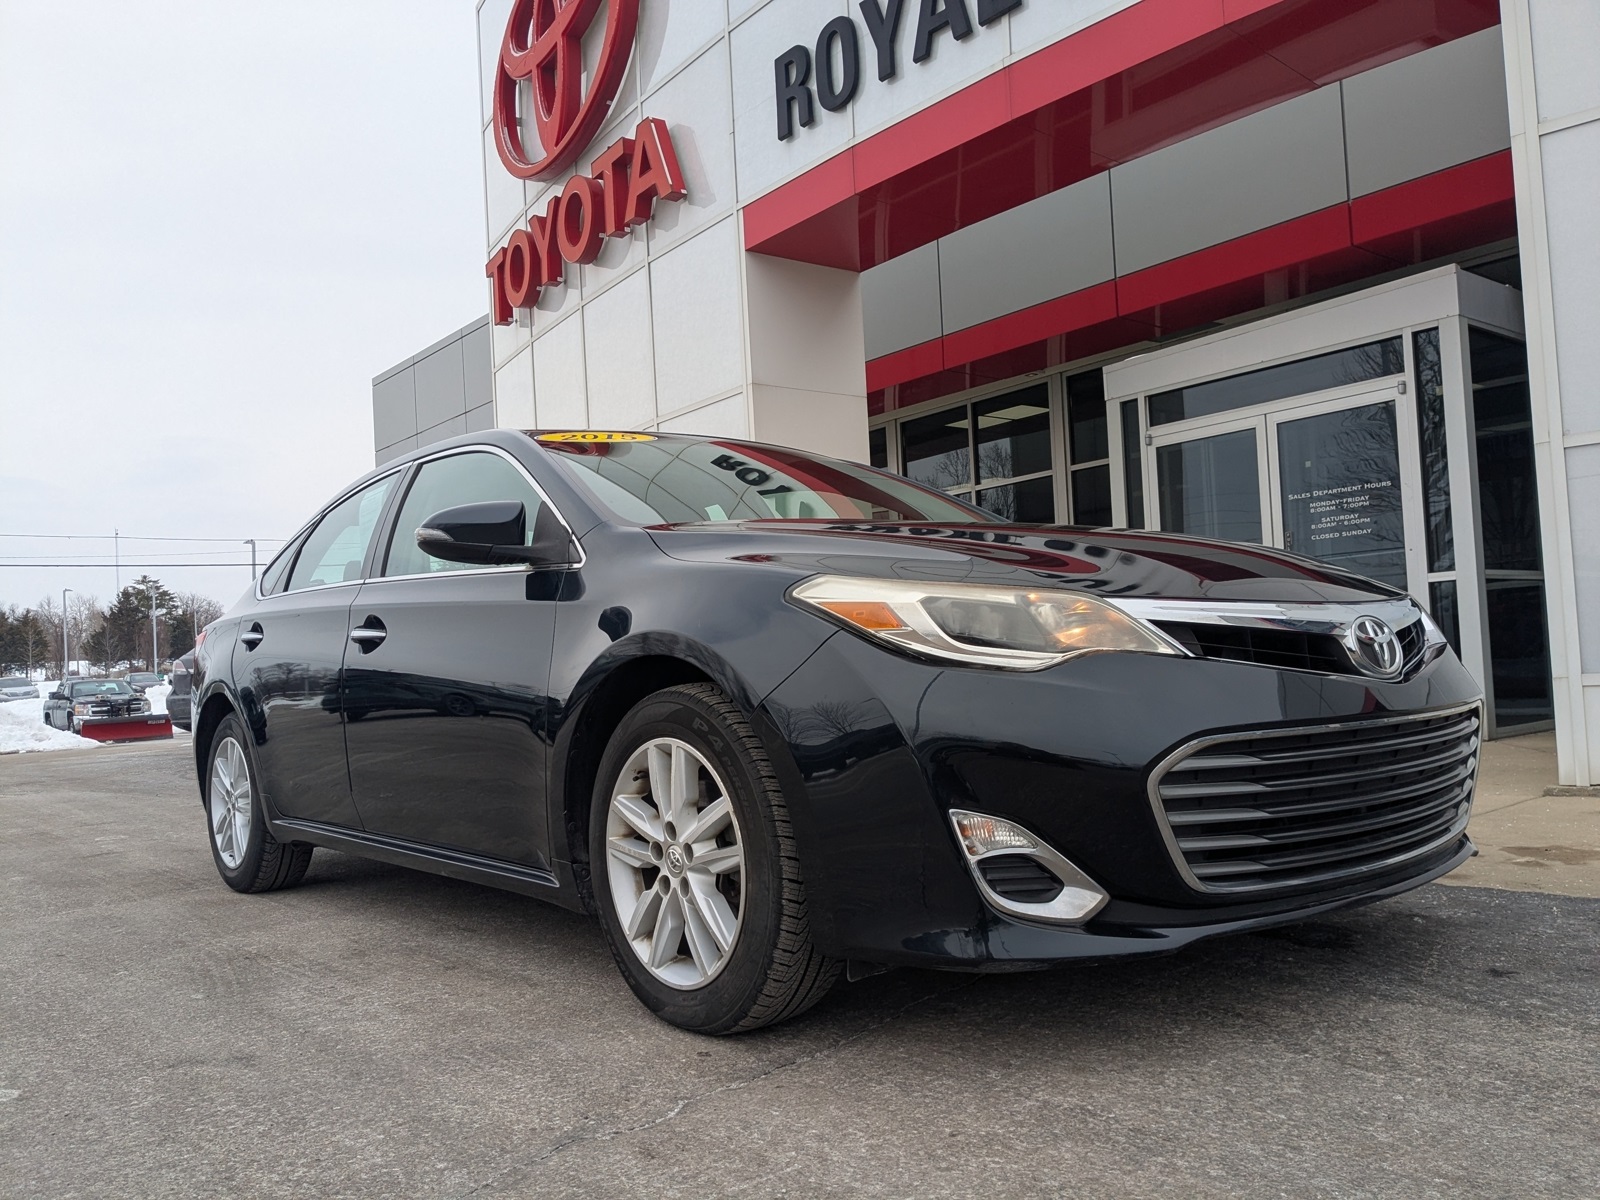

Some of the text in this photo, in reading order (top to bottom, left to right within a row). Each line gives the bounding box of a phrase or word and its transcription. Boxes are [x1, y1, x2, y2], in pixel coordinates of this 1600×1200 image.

[774, 0, 1022, 141] ROYA
[485, 116, 688, 326] TOYOTA
[560, 433, 637, 441] 2015
[1310, 495, 1370, 507] MONDAY-FRIDAY
[1310, 505, 1336, 513] 8:00AM
[1343, 501, 1370, 509] 7:00PM
[1321, 513, 1359, 522] SATURDAY
[1311, 528, 1372, 540] CLOSED SUNDAY
